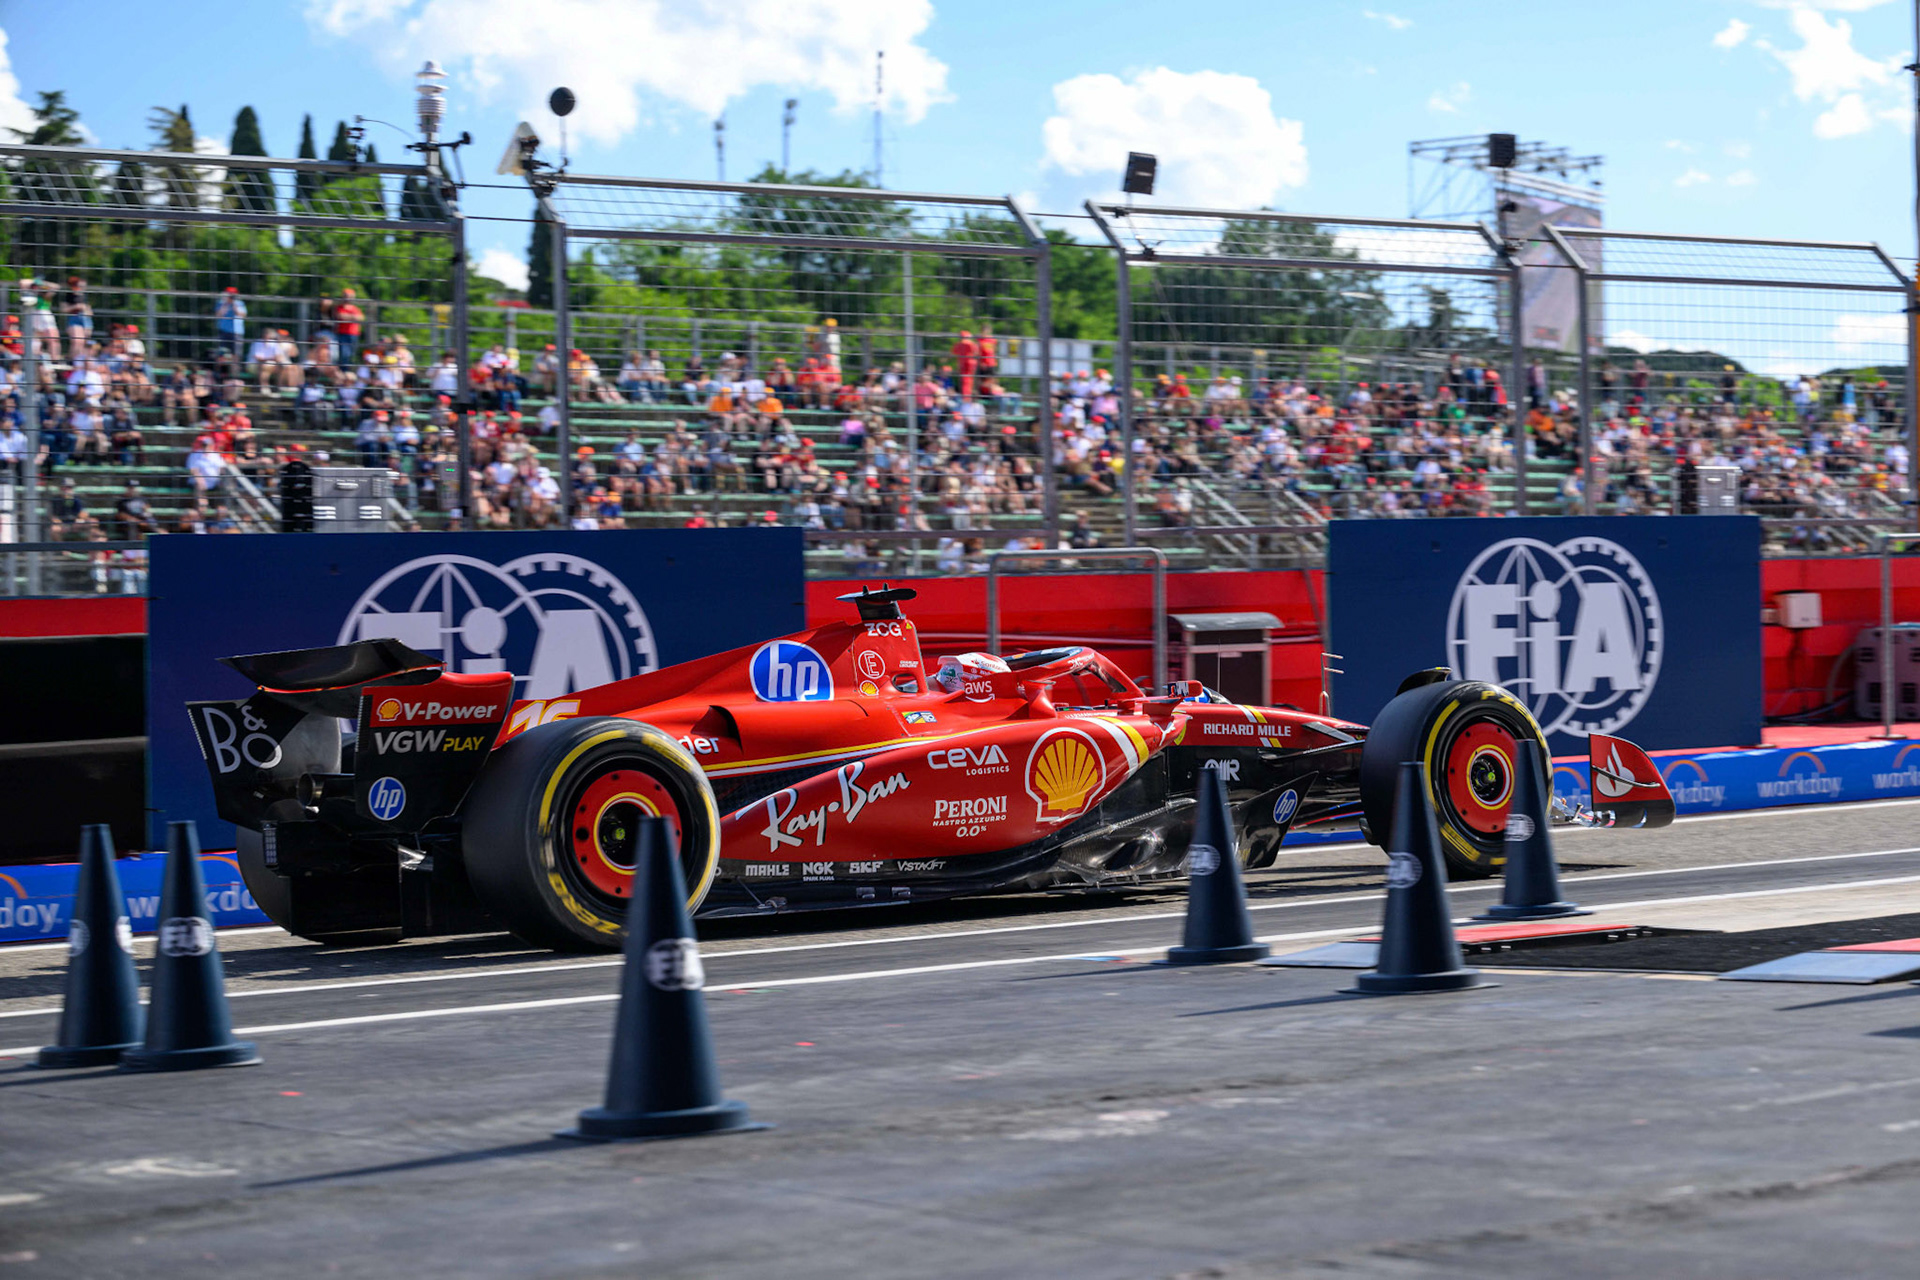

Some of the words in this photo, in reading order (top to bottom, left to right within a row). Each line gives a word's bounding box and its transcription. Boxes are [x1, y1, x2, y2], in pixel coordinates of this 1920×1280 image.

[864, 622, 902, 637] ZCG
[768, 643, 819, 701] hp
[964, 680, 993, 695] aws
[403, 702, 498, 721] V-Power
[1203, 723, 1254, 736] RICHARD
[1257, 724, 1292, 737] MILLE
[374, 729, 447, 755] VGW
[442, 736, 485, 752] PLAY
[966, 765, 1010, 776] LOGISTICS
[374, 779, 401, 819] hp
[1669, 780, 1726, 807] rkday
[934, 795, 1008, 820] PERONI
[1275, 790, 1295, 822] hp
[932, 819, 967, 827] NASTRO
[968, 814, 1007, 824] AZZURRO
[745, 864, 790, 877] MAHLE
[802, 861, 835, 876] NGK
[849, 860, 884, 875] SKF
